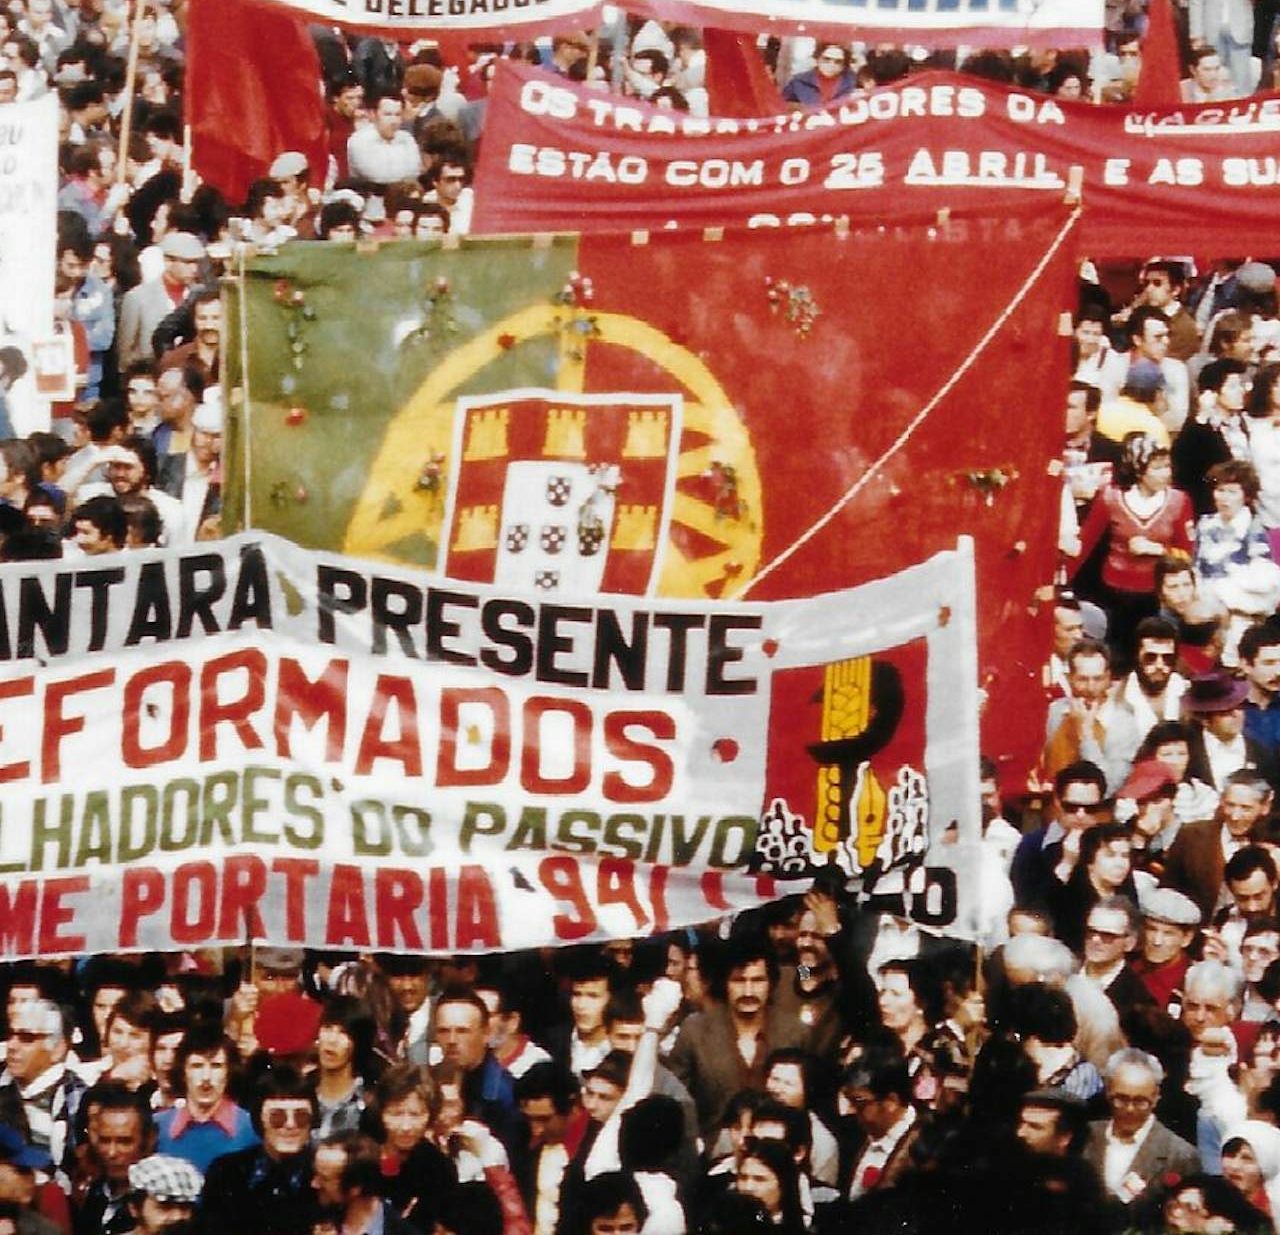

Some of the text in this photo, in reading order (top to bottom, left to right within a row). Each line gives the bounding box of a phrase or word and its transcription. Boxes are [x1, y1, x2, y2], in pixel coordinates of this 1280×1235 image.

[521, 80, 577, 119] OS
[1007, 92, 1065, 124] DA
[665, 159, 763, 188] COM
[779, 158, 811, 185] O
[825, 152, 884, 189] 25
[905, 148, 1065, 188] ABRIL
[1104, 157, 1130, 185] E
[1148, 157, 1204, 185] AS
[318, 563, 763, 696] PRESENTE
[350, 798, 430, 857] DO
[458, 800, 758, 866] PASSIVO
[118, 852, 503, 952] PORTARIA
